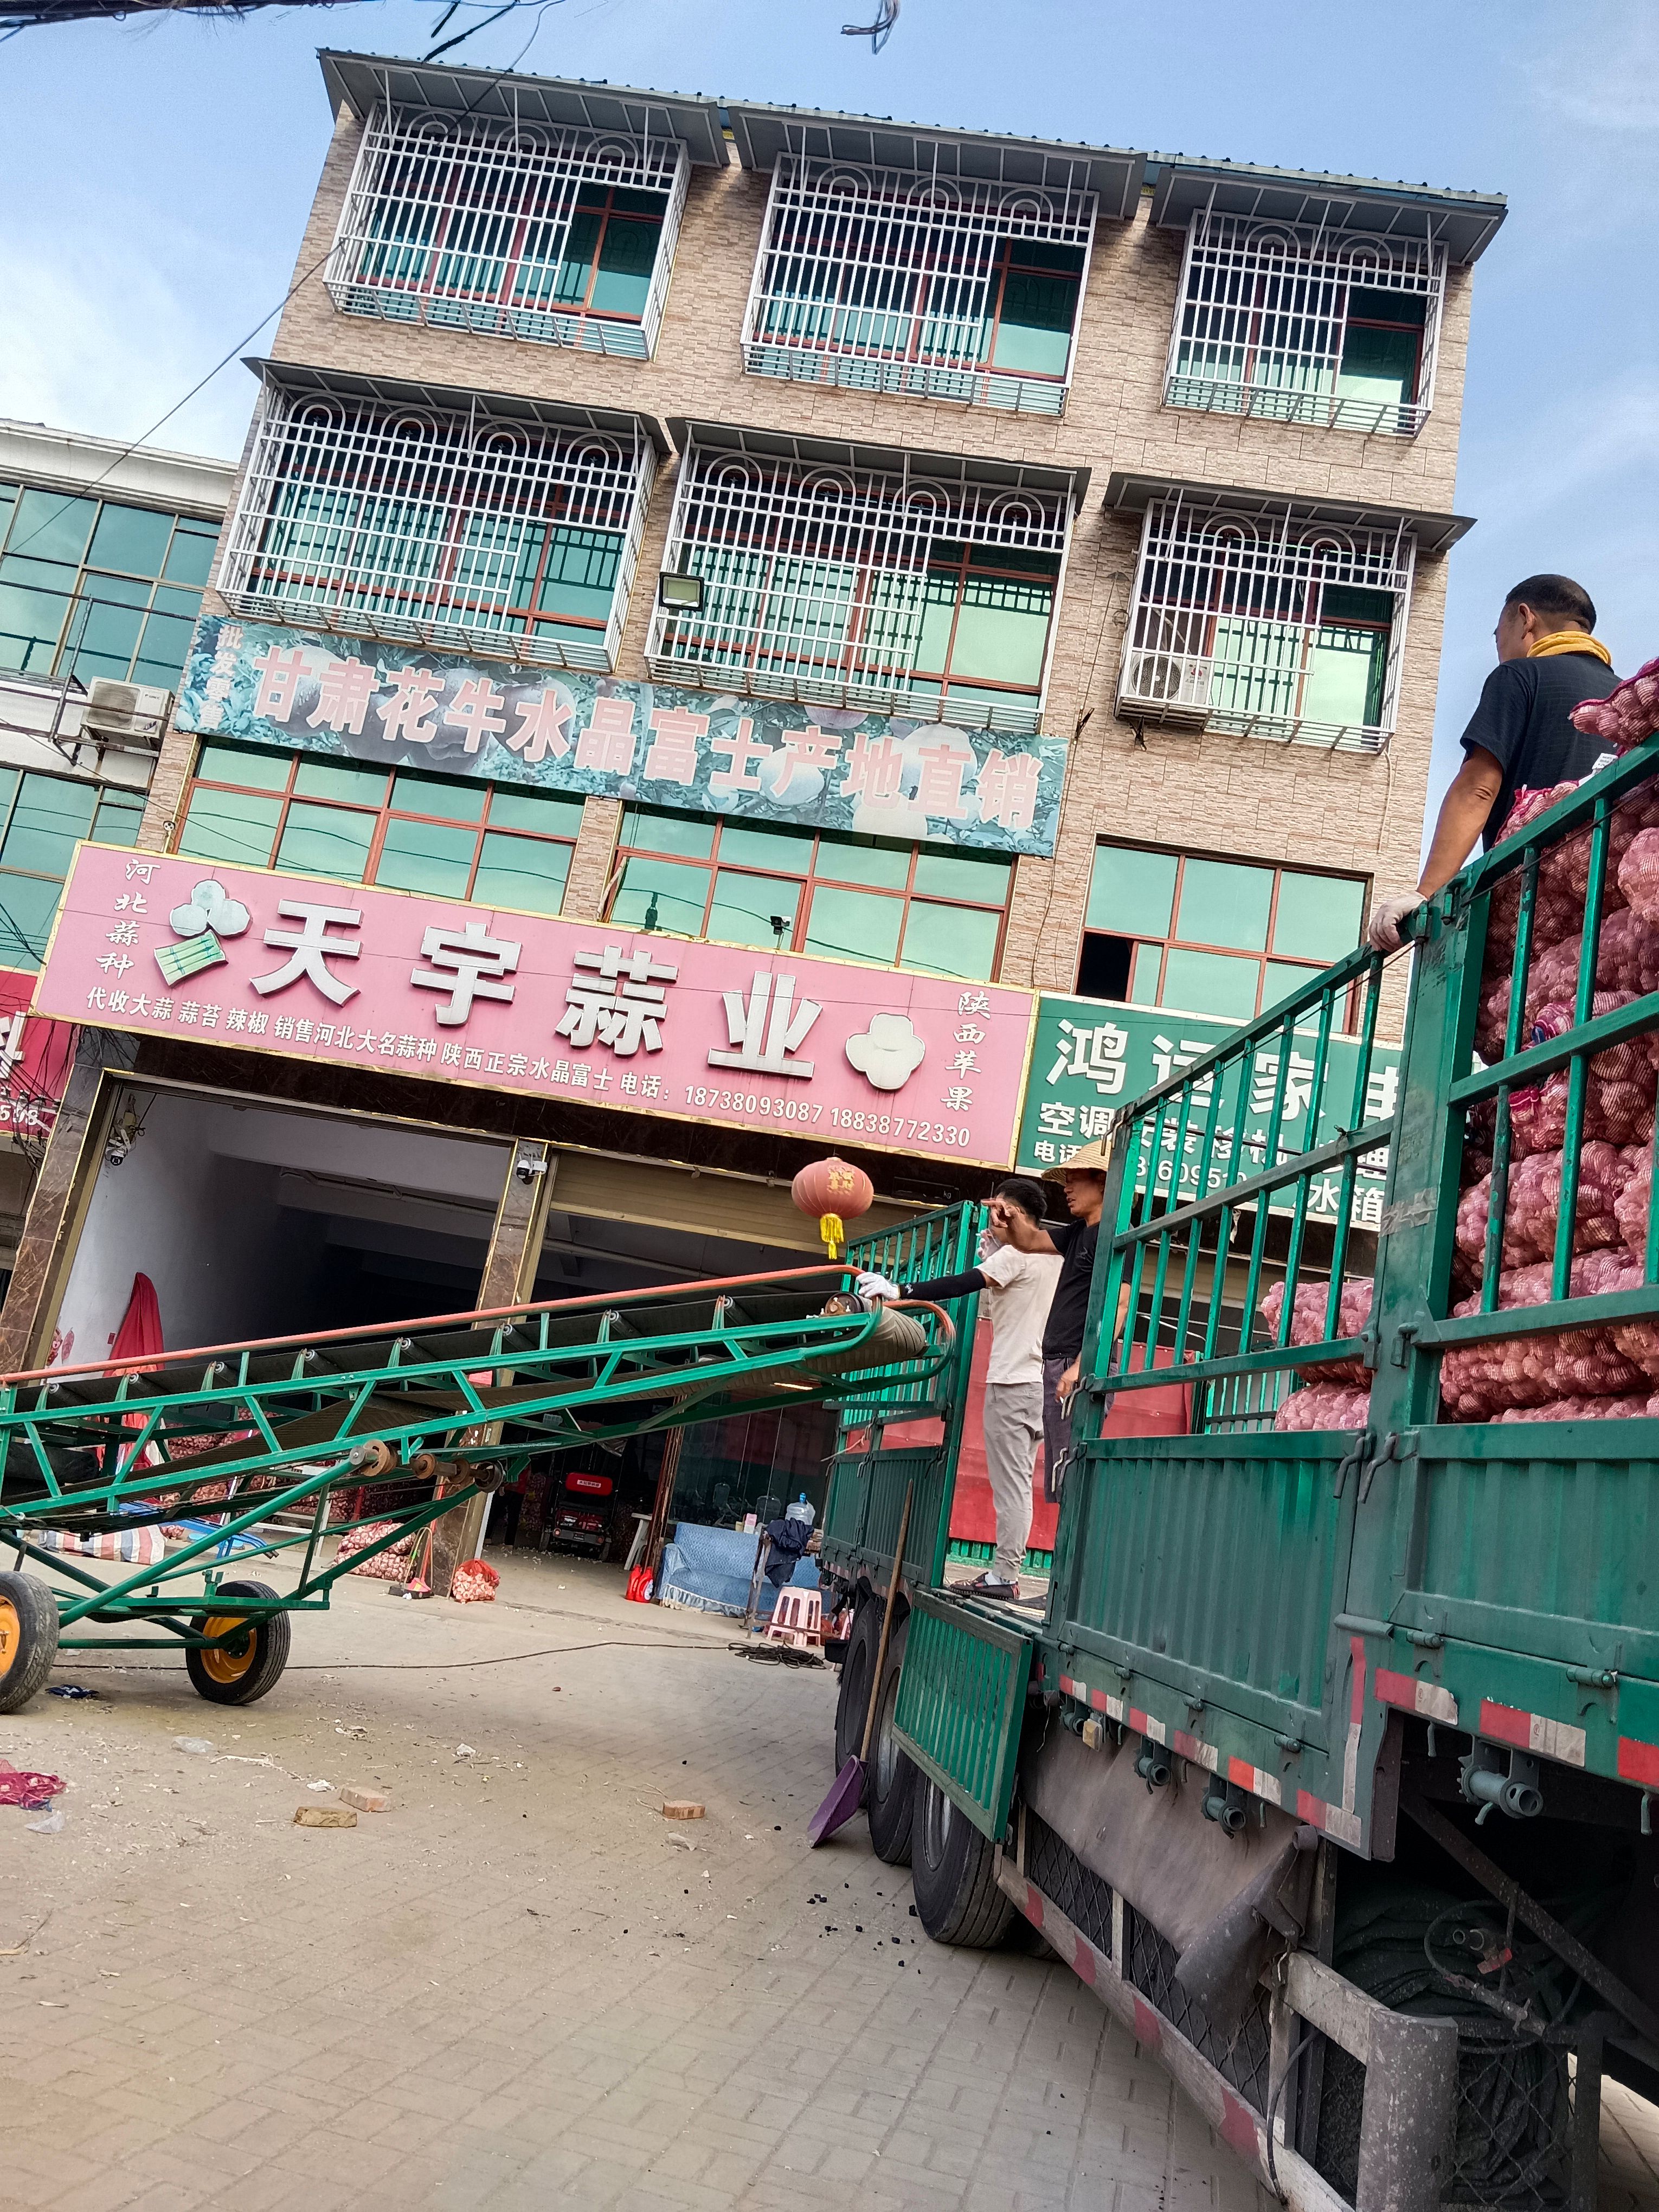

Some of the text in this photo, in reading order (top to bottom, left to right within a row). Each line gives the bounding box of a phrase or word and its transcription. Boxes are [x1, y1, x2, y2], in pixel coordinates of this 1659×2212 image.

[200, 623, 243, 730] 批发零售
[253, 645, 1044, 829] 甘肃花牛水晶富士产地直销
[96, 858, 160, 979] 河北蒜种
[249, 898, 824, 1080] 天宇蒜业
[86, 986, 172, 1020] 代收大蒜
[178, 1000, 222, 1028] 蒜苔
[226, 1007, 269, 1034] 辣椒
[273, 1014, 436, 1063] 销售河北大名蒜种
[440, 1045, 614, 1091] 陕西正宗水晶富士
[684, 1084, 823, 1123] 18738093087
[829, 1107, 970, 1147] 18838772330
[940, 990, 991, 1112] 陕西苹果
[943, 1190, 951, 1199] kg
